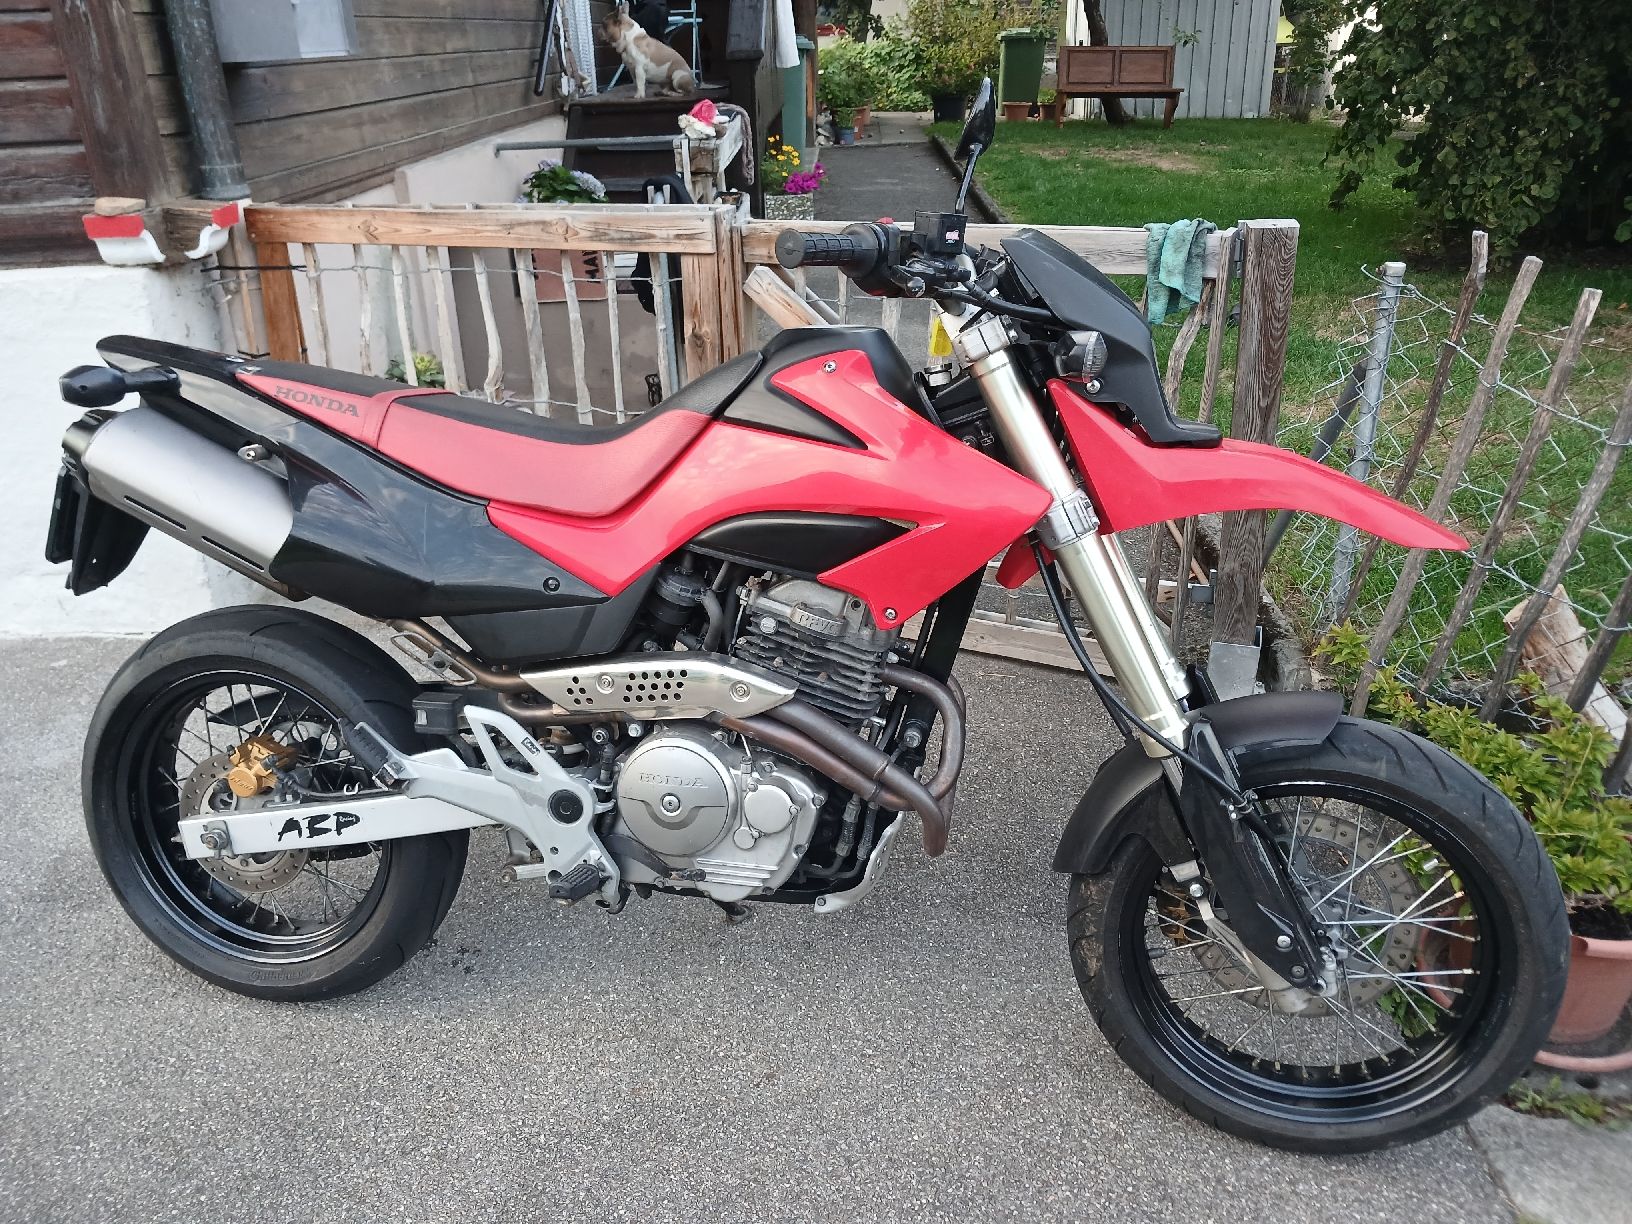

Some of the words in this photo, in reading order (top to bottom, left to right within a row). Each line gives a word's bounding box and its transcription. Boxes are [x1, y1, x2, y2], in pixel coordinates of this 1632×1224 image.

[273, 385, 360, 418] HONDA
[639, 772, 708, 788] HONDA
[277, 811, 361, 842] ABP
